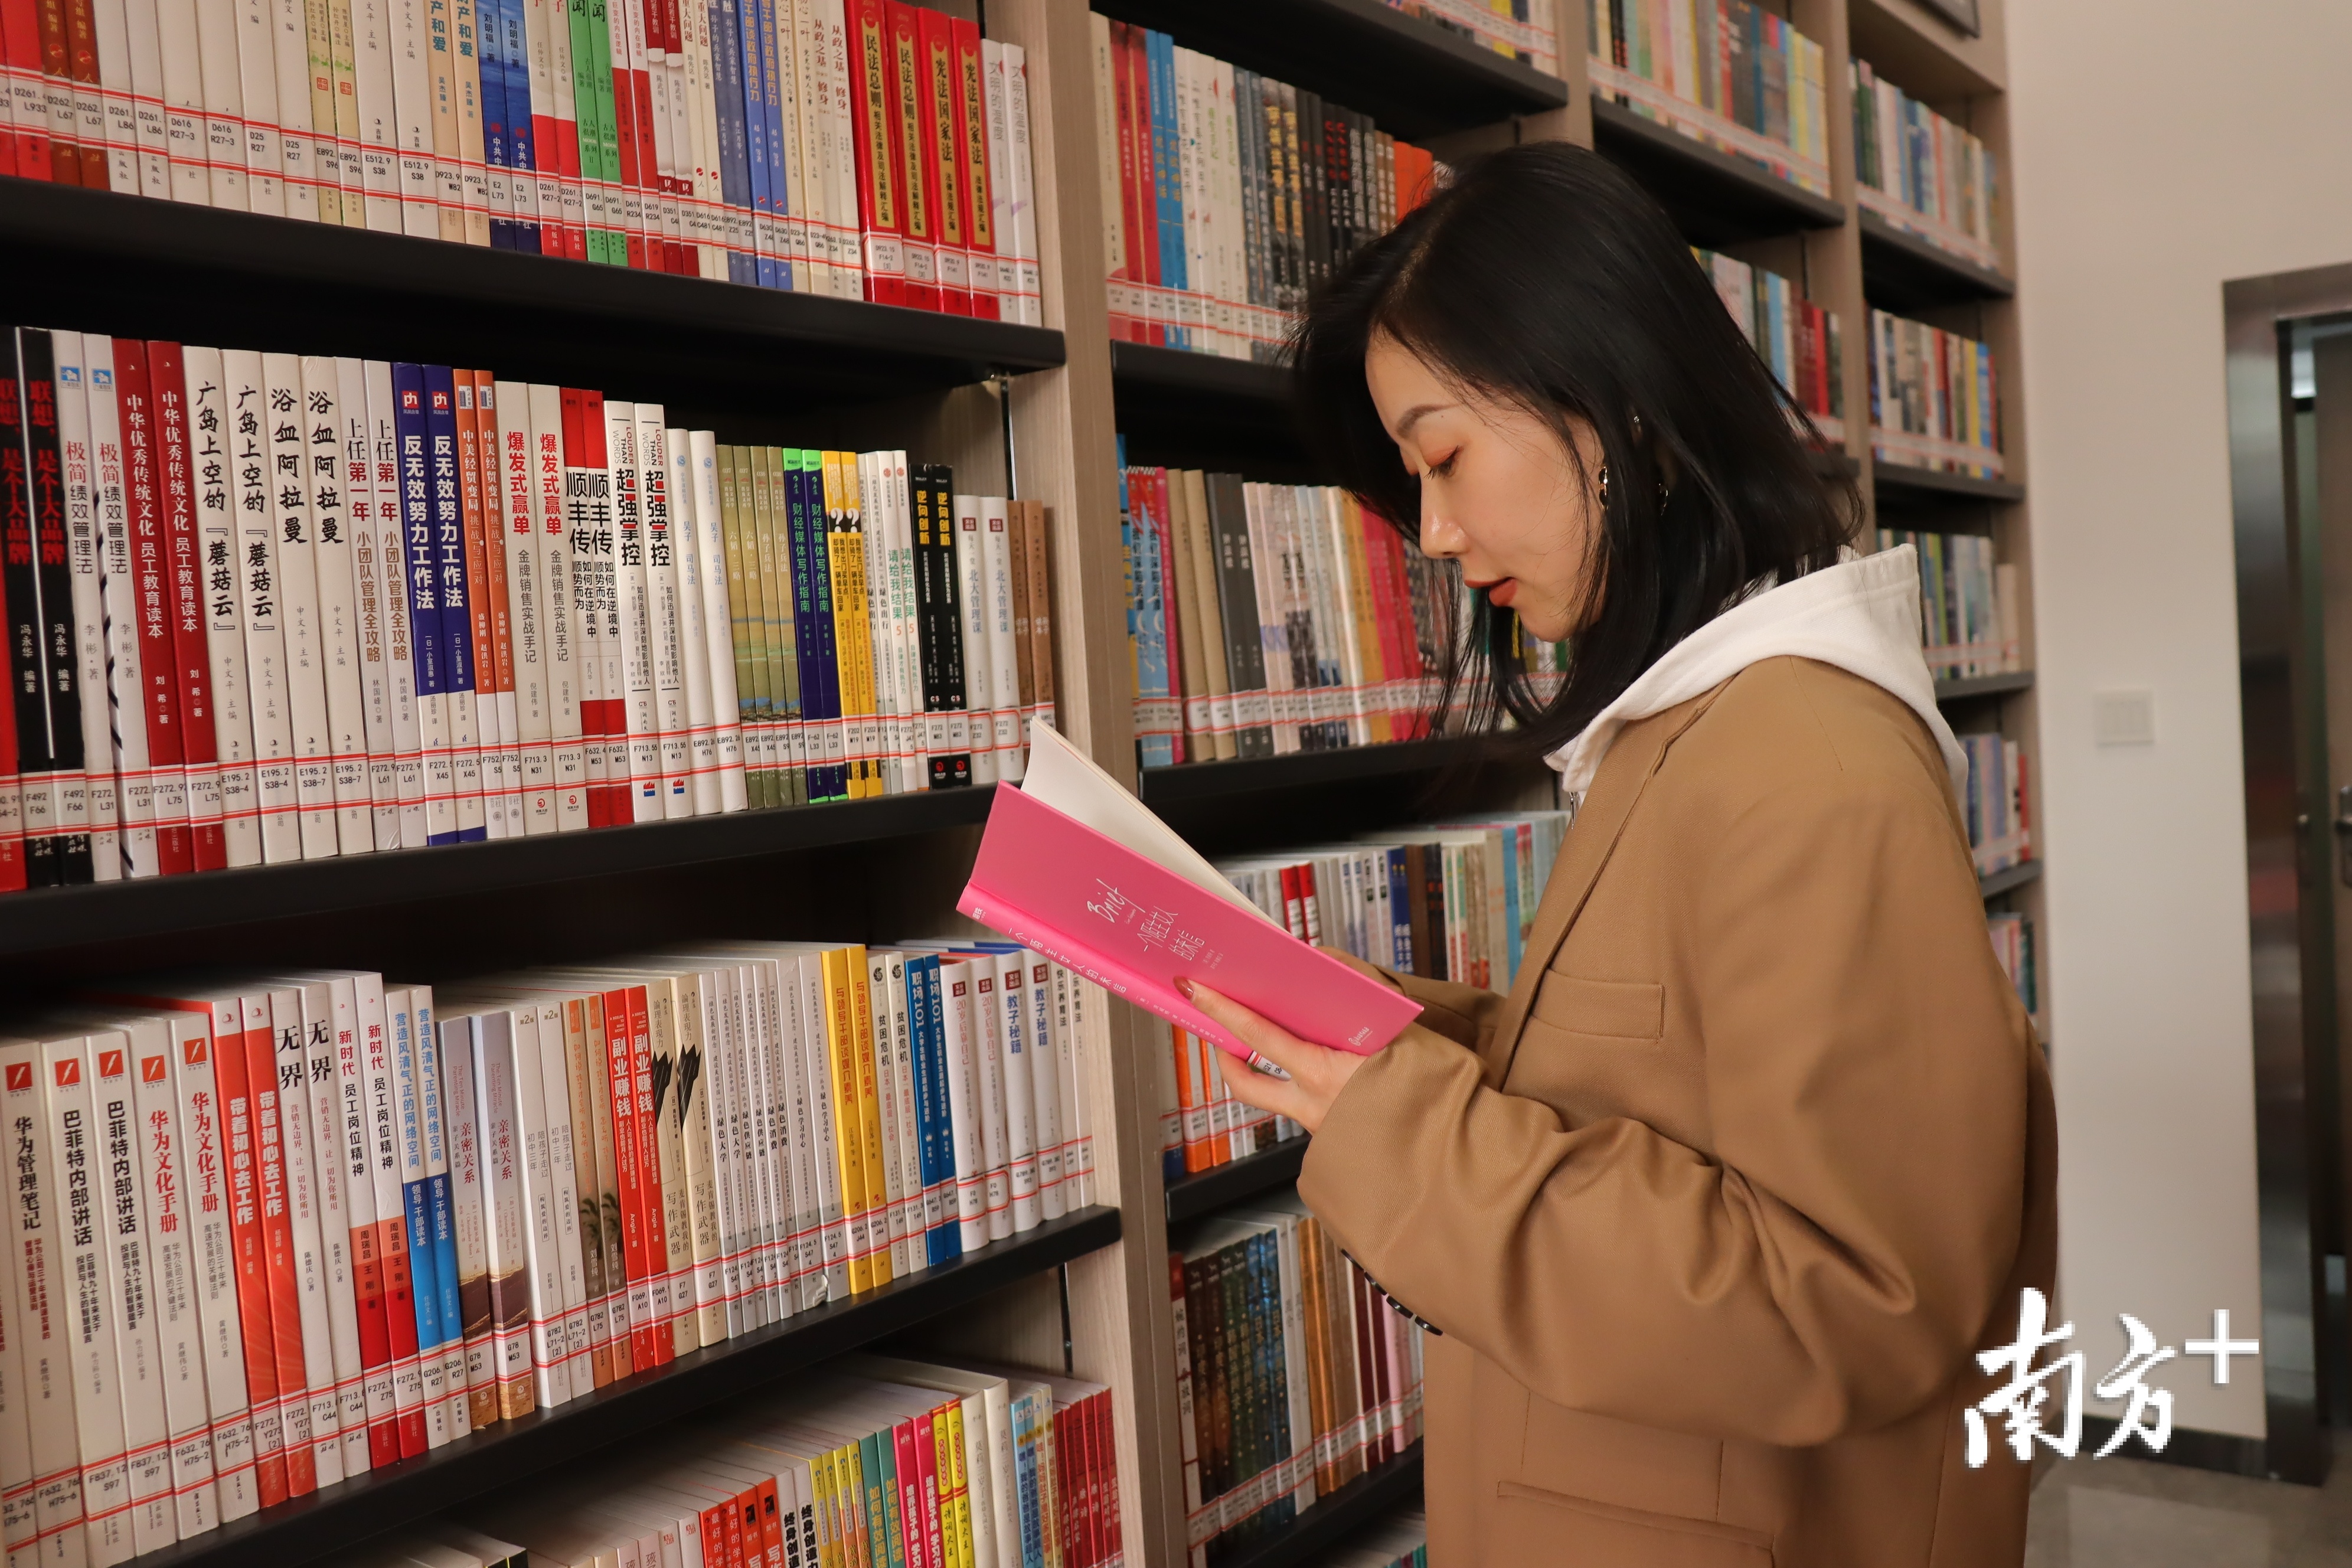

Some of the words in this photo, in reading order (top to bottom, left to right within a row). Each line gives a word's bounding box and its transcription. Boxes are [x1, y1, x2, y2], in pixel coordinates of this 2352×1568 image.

[484, 14, 494, 43] 刘明福
[509, 19, 519, 48] 刘明福
[814, 19, 827, 67] 从政之基
[832, 25, 844, 72] 从政之基
[486, 53, 495, 63] 著
[512, 59, 520, 68] 著
[867, 35, 881, 108] 民法总则
[900, 48, 914, 119] 民法总则
[818, 81, 828, 105] 修身
[836, 86, 847, 110] 修身
[936, 58, 952, 162] 宪法国家法
[966, 62, 982, 165] 宪法国家法
[170, 129, 195, 141] R27-3
[171, 119, 191, 128] D616
[250, 132, 264, 141] D25
[251, 143, 265, 152] R27
[365, 155, 390, 165] E512.9
[374, 166, 386, 175] S38
[492, 191, 504, 200] L73
[271, 388, 308, 544] 浴血阿拉曼
[308, 390, 344, 544] 浴血阿拉曼
[345, 419, 371, 522] 上任第一年
[375, 419, 398, 522] 上任第一年
[463, 430, 479, 512] 中美经贸变局
[484, 430, 499, 511] 中美经贸变局
[612, 430, 622, 464] WORDS
[625, 426, 634, 465] LOUDER
[642, 432, 651, 466] WORDS
[649, 440, 658, 466] THAN
[655, 429, 664, 466] LOUDER
[66, 440, 94, 574] 极简绩效管理法
[99, 443, 128, 574] 极简绩效管理法
[161, 391, 190, 531] 中华优秀传统文化
[176, 537, 198, 632] 员工教育读本
[507, 432, 531, 535] 爆发式赢单
[540, 434, 563, 535] 爆发式赢单
[126, 394, 156, 537] 中华优秀传统文化
[141, 542, 164, 638] 员工教育读本
[404, 435, 435, 610] 反无效努力工作法
[434, 436, 463, 608] 反无效努力工作法
[566, 472, 590, 555] 顺丰传
[588, 474, 612, 555] 顺丰传
[616, 468, 641, 567] 超强掌控
[645, 471, 671, 567] 超强掌控
[710, 521, 719, 543] 吴子
[916, 490, 930, 545] 逆向创新
[937, 492, 950, 546] 逆向创新
[572, 561, 584, 610] 顺势而为
[594, 561, 606, 610] 顺势而为
[712, 555, 723, 586] 司马法
[792, 502, 811, 613] 财经媒体写作指南
[811, 504, 829, 613] 财经媒体写作指南
[833, 538, 844, 613] 却骑了一辆单车回家
[888, 549, 903, 620] 请给我结果
[901, 548, 916, 617] 请给我结果
[356, 531, 381, 662] 小团队管理全攻略
[384, 531, 408, 661] 小团队管理全攻略
[518, 550, 537, 663] 金牌销售实战手记
[550, 550, 569, 662] 金牌销售实战手记
[583, 561, 596, 638] 如何在逆境中
[604, 561, 618, 638] 如何在逆境中
[54, 623, 67, 657] 冯永华
[636, 586, 650, 685] 如何迅速并深刻地影响他人
[896, 625, 901, 636] 5
[909, 623, 914, 633] 5
[58, 669, 70, 692] 编著
[263, 657, 274, 690] 申文平
[898, 647, 906, 694] 自律才有执行力
[267, 698, 277, 720] 主编
[262, 768, 290, 779] E195.2
[265, 779, 289, 789] S38-4
[300, 766, 328, 777] E195.2
[303, 778, 326, 788] S38-7
[559, 753, 581, 762] F713.3
[27, 792, 47, 803] F492
[30, 805, 45, 814] F66
[1008, 927, 1127, 994] 一个陌生女人的来信
[1168, 929, 1206, 961] 的来信
[544, 1010, 558, 1021] 第2版
[653, 1000, 664, 1048] 論理表現力
[682, 995, 692, 1041] 論理表現力
[856, 982, 873, 1098] 与领导干部谈媒介素养
[878, 1015, 890, 1066] 贫困危机
[897, 1012, 908, 1062] 贫困危机
[1007, 995, 1022, 1054] 教子秘籍
[1035, 989, 1048, 1047] 教子秘籍
[276, 1026, 302, 1090] 无界
[306, 1020, 331, 1084] 无界
[339, 1031, 355, 1076] 新时代
[368, 1025, 384, 1070] 新时代
[634, 1034, 653, 1113] 副业赚钱
[837, 988, 853, 1105] 与领导干部谈媒介素养
[395, 1013, 420, 1167] 营造风清气正的网络空间
[419, 1009, 441, 1161] 营造风清气正的网络空间
[612, 1040, 632, 1117] 副业赚钱
[345, 1084, 364, 1177] 员工岗位精神
[375, 1077, 393, 1170] 员工岗位精神
[717, 1119, 727, 1162] 绿色大学
[743, 1110, 752, 1159] 绿色供应链
[778, 1103, 788, 1146] 绿色消费
[820, 1092, 829, 1142] 绿色学习中心
[14, 1116, 41, 1230] 华为管理笔记
[108, 1101, 136, 1235] 巴菲特内部讲话
[149, 1110, 178, 1234] 华为文化手册
[191, 1092, 218, 1214] 华为文化手册
[230, 1097, 254, 1226] 带着初心去工作
[259, 1091, 283, 1217] 带着初心去工作
[460, 1122, 475, 1184] 亲密关系
[497, 1120, 512, 1181] 亲密关系
[527, 1133, 537, 1170] 初中三年
[537, 1131, 549, 1178] 陪孩子走过
[551, 1128, 561, 1164] 初中三年
[561, 1125, 573, 1172] 陪孩子走过
[619, 1121, 628, 1172] 副业也能月入过万
[64, 1110, 92, 1246] 巴菲特内部讲话
[540, 1196, 548, 1240] 构筑爱的边界
[667, 1192, 681, 1256] 写作武器
[679, 1190, 689, 1251] 麦肯锡教我的
[695, 1183, 709, 1246] 写作武器
[204, 1224, 218, 1300] 高速发展的关键法则
[213, 1222, 227, 1289] 华为公司三十年来
[547, 1327, 561, 1337] G782
[547, 1336, 564, 1348] L71-2
[145, 1466, 160, 1477] S97
